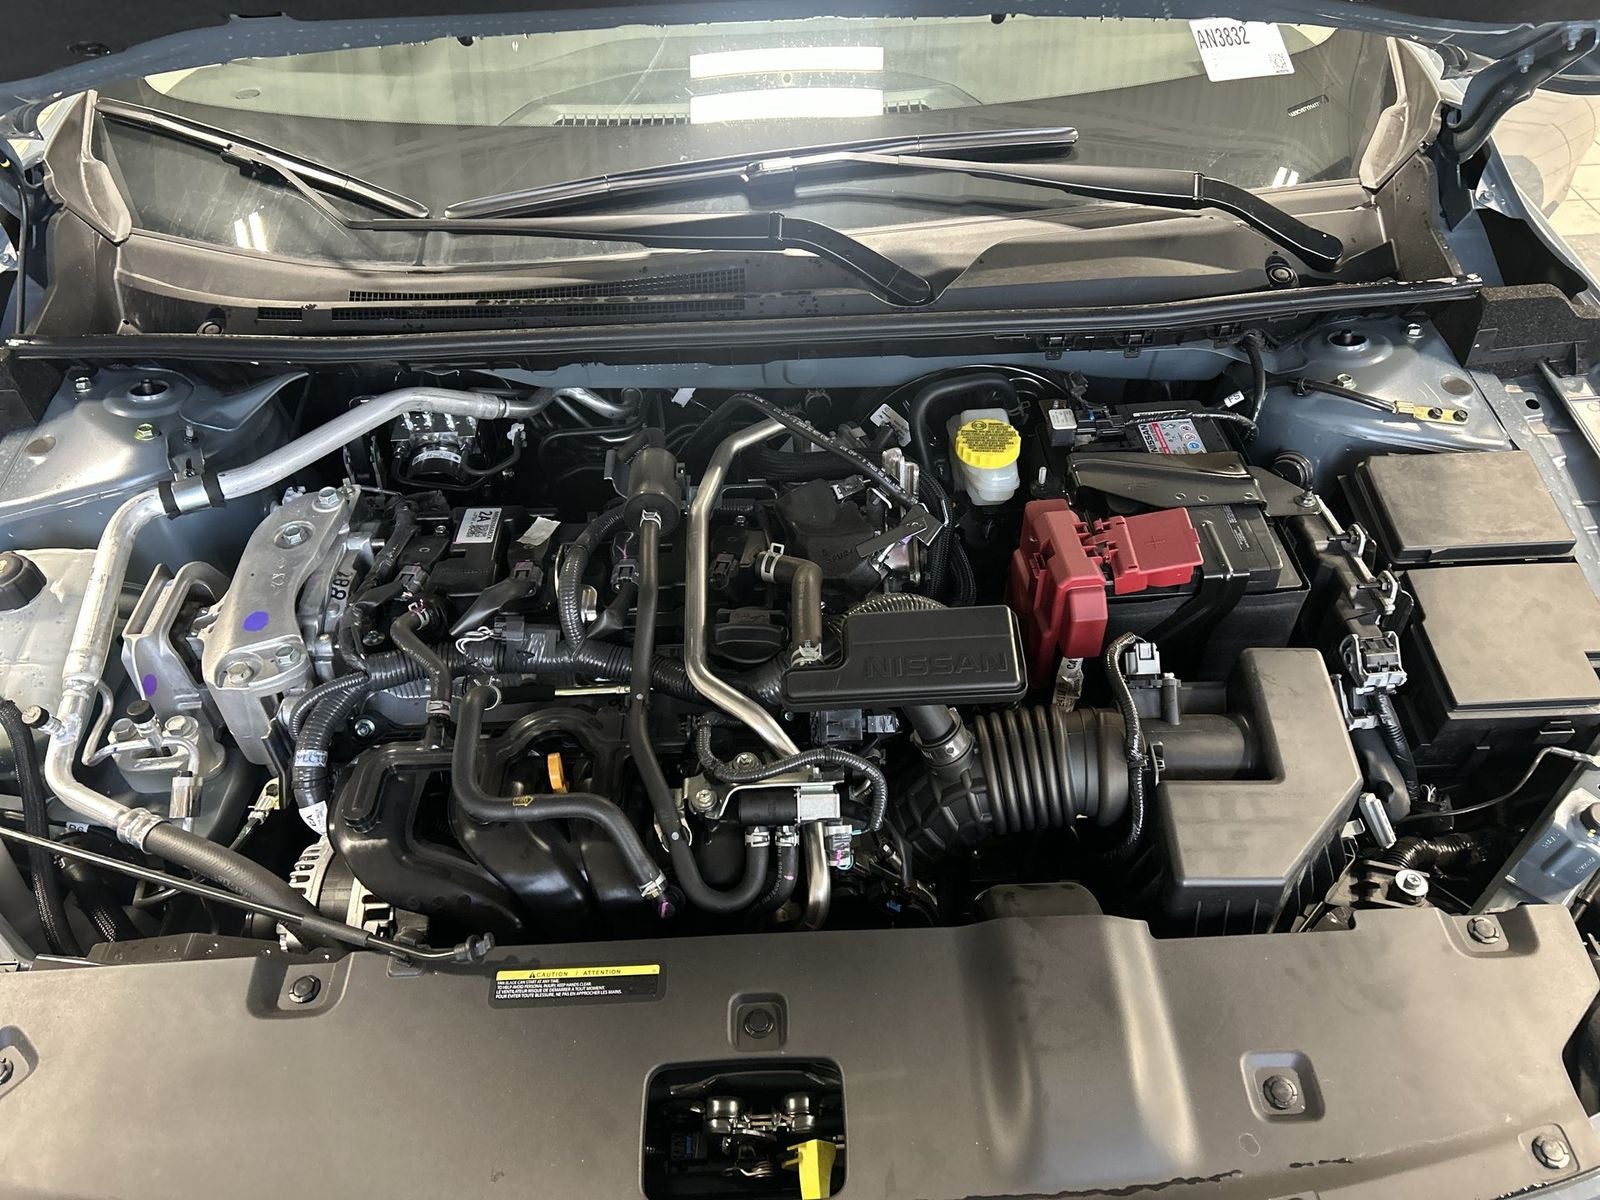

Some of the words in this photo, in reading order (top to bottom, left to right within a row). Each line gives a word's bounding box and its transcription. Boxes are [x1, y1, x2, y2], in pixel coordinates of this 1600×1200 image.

[1197, 25, 1250, 49] AN3832
[1140, 424, 1159, 453] NISSAN
[864, 651, 1009, 679] NISSAN
